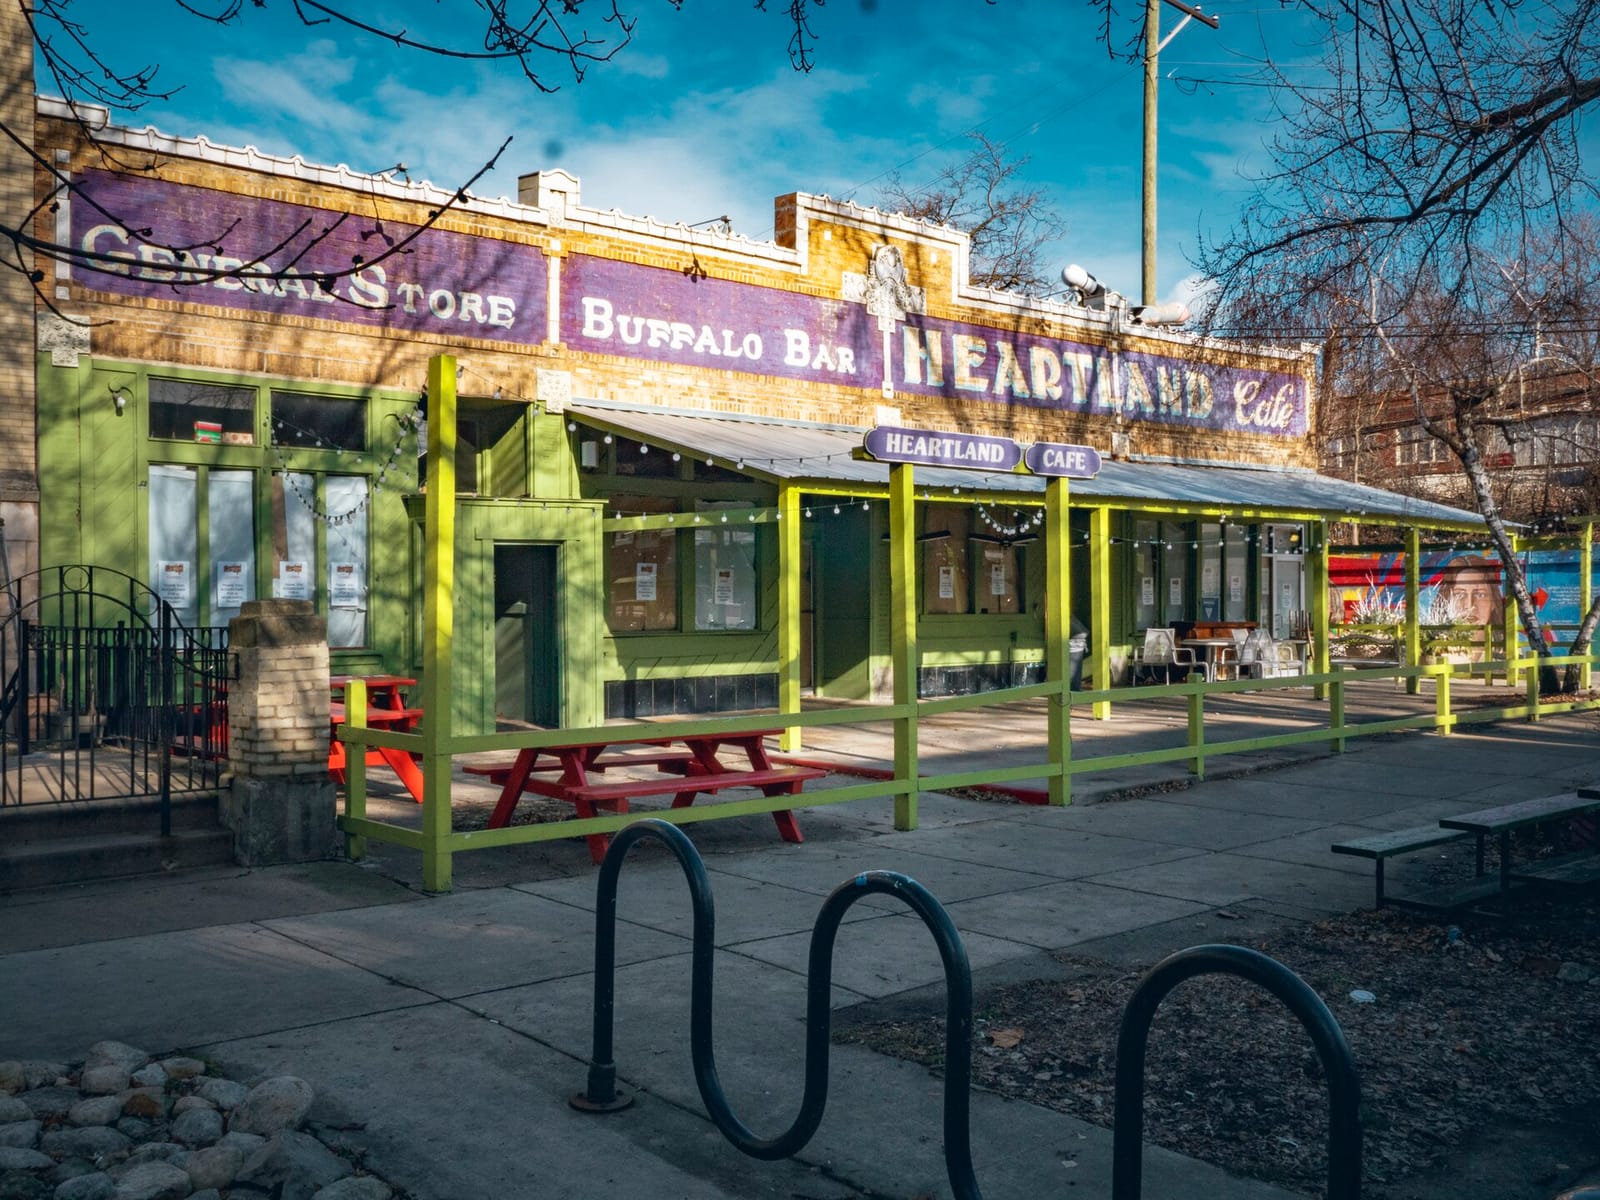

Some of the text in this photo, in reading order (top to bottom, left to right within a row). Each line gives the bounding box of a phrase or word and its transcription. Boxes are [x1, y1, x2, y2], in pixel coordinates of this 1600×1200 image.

[82, 224, 516, 330] GENERAL STORE
[581, 297, 856, 375] BUFFALO BAR
[902, 325, 1214, 420] HEARTLAND
[885, 433, 1005, 464] HEARTLAND
[1042, 448, 1086, 471] CAFE
